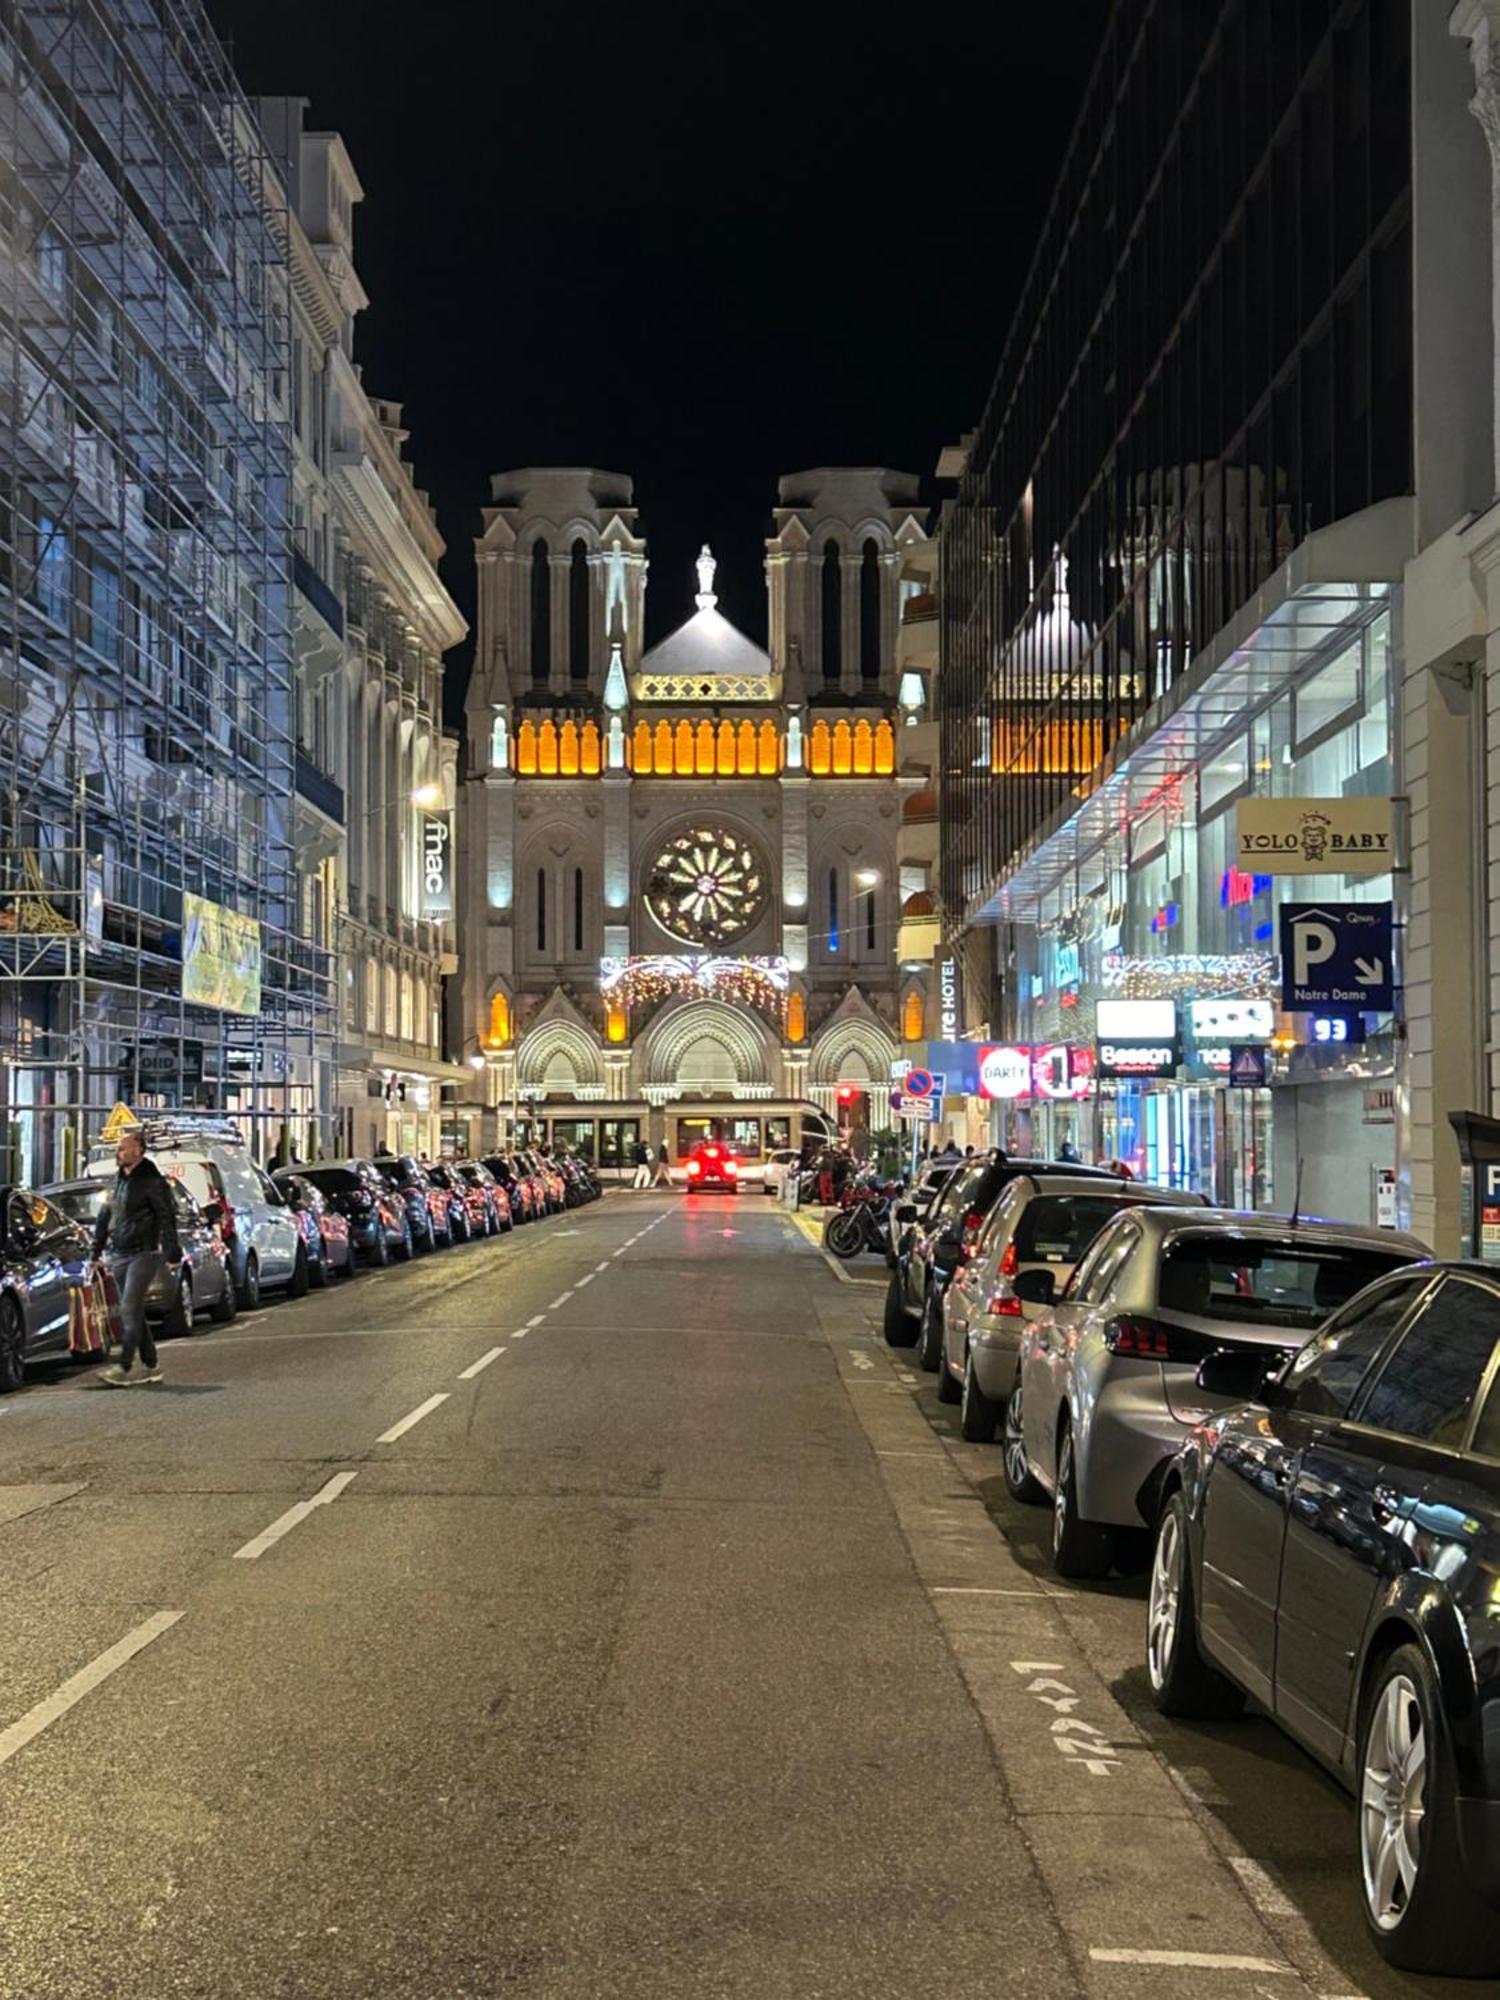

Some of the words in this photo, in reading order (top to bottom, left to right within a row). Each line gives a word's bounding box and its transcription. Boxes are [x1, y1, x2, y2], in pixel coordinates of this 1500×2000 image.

[1242, 833, 1298, 849] YOLO
[1331, 833, 1389, 849] BABY
[425, 822, 448, 894] fnac
[1294, 922, 1337, 986] P
[941, 956, 955, 1009] HOTEL
[1294, 988, 1329, 1001] Notre
[1332, 988, 1367, 1001] Dame
[1314, 1019, 1347, 1041] 93
[984, 1066, 1025, 1079] DARTY
